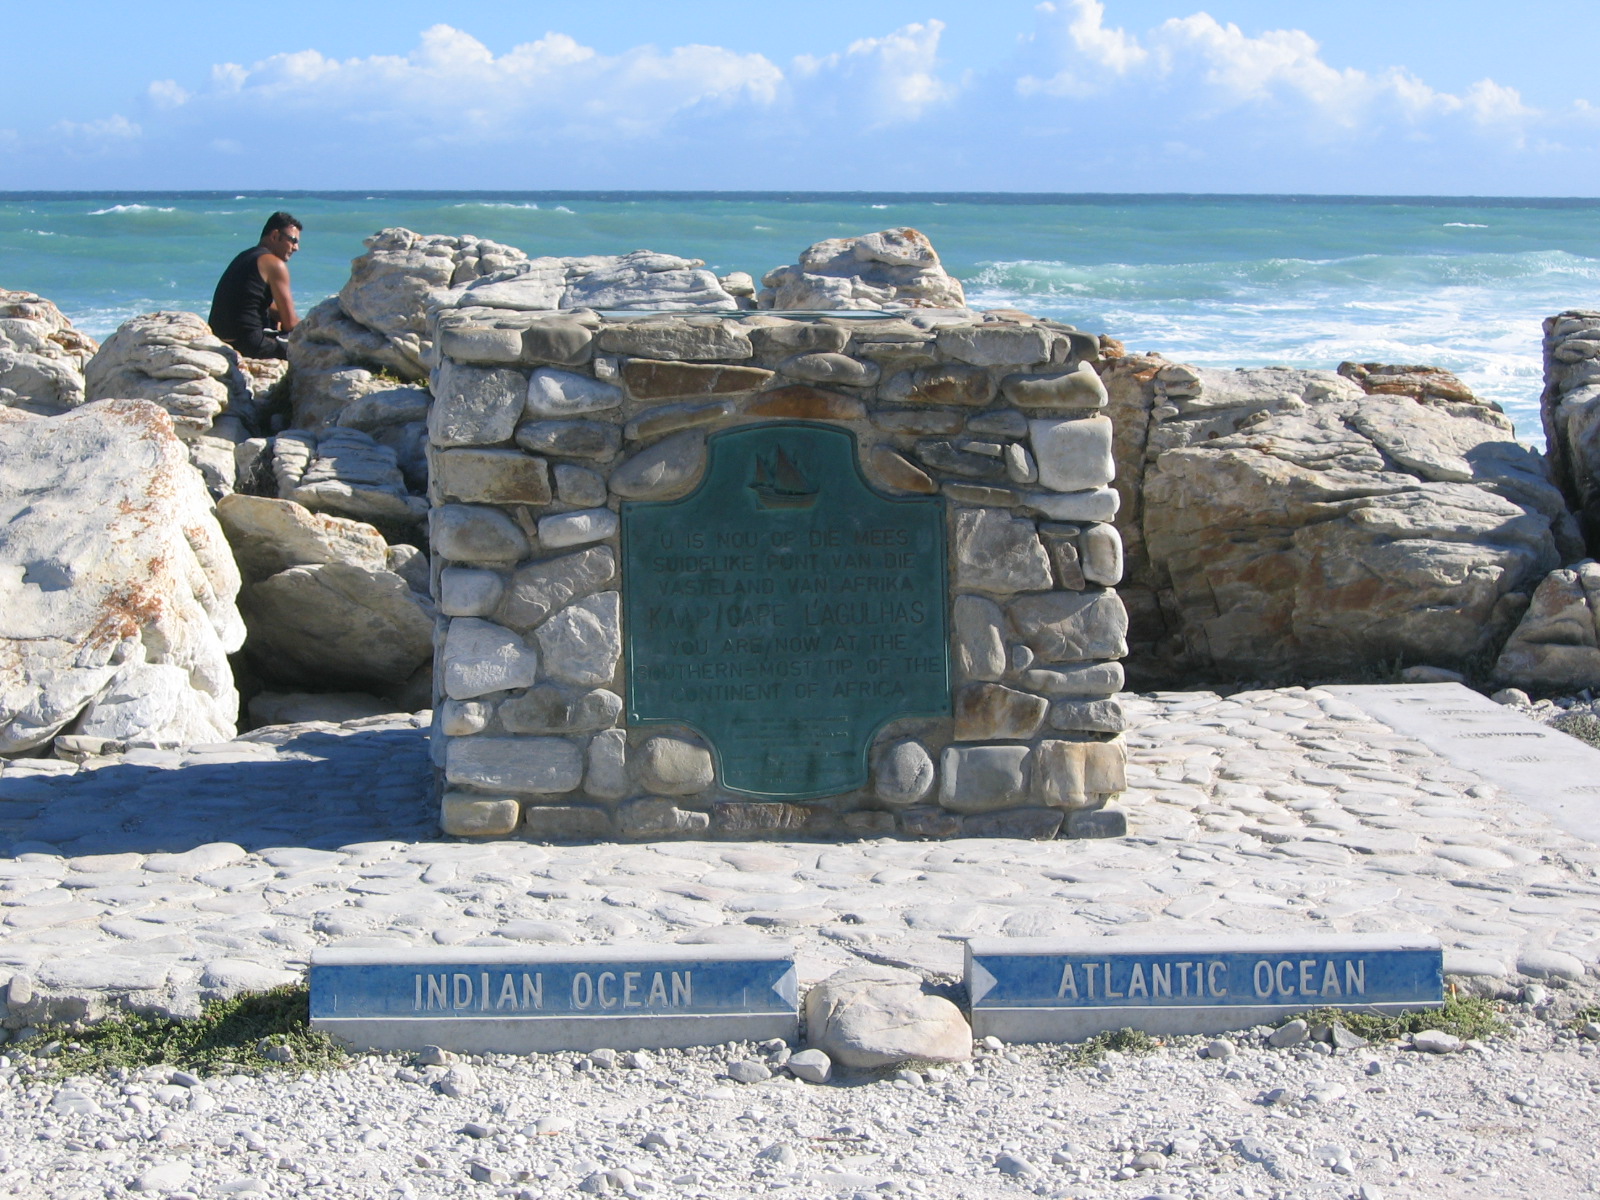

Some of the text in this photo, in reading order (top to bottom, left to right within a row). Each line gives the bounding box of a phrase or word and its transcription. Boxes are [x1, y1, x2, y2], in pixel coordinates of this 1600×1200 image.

[661, 533, 673, 549] U
[687, 533, 705, 549] IS
[716, 531, 758, 549] NOU
[810, 529, 841, 547] DIE
[855, 529, 909, 546] MEES
[653, 552, 916, 573] SUIDELIKE PUNT VAN DIE
[658, 575, 915, 597] VASTELAND VAN AFRIKA
[805, 599, 926, 627] L'AGULHAS
[670, 638, 709, 656] YOU
[775, 636, 820, 653] NOW
[833, 635, 857, 651] AT
[869, 634, 907, 650] THE
[825, 658, 853, 675] TIP
[866, 657, 891, 675] OF
[904, 655, 942, 673] THE
[671, 680, 906, 703] CONTINENT OF AFRICA
[414, 970, 693, 1010] INDIAN OCEAN
[1057, 959, 1366, 999] ATLANTIC OCEAN
